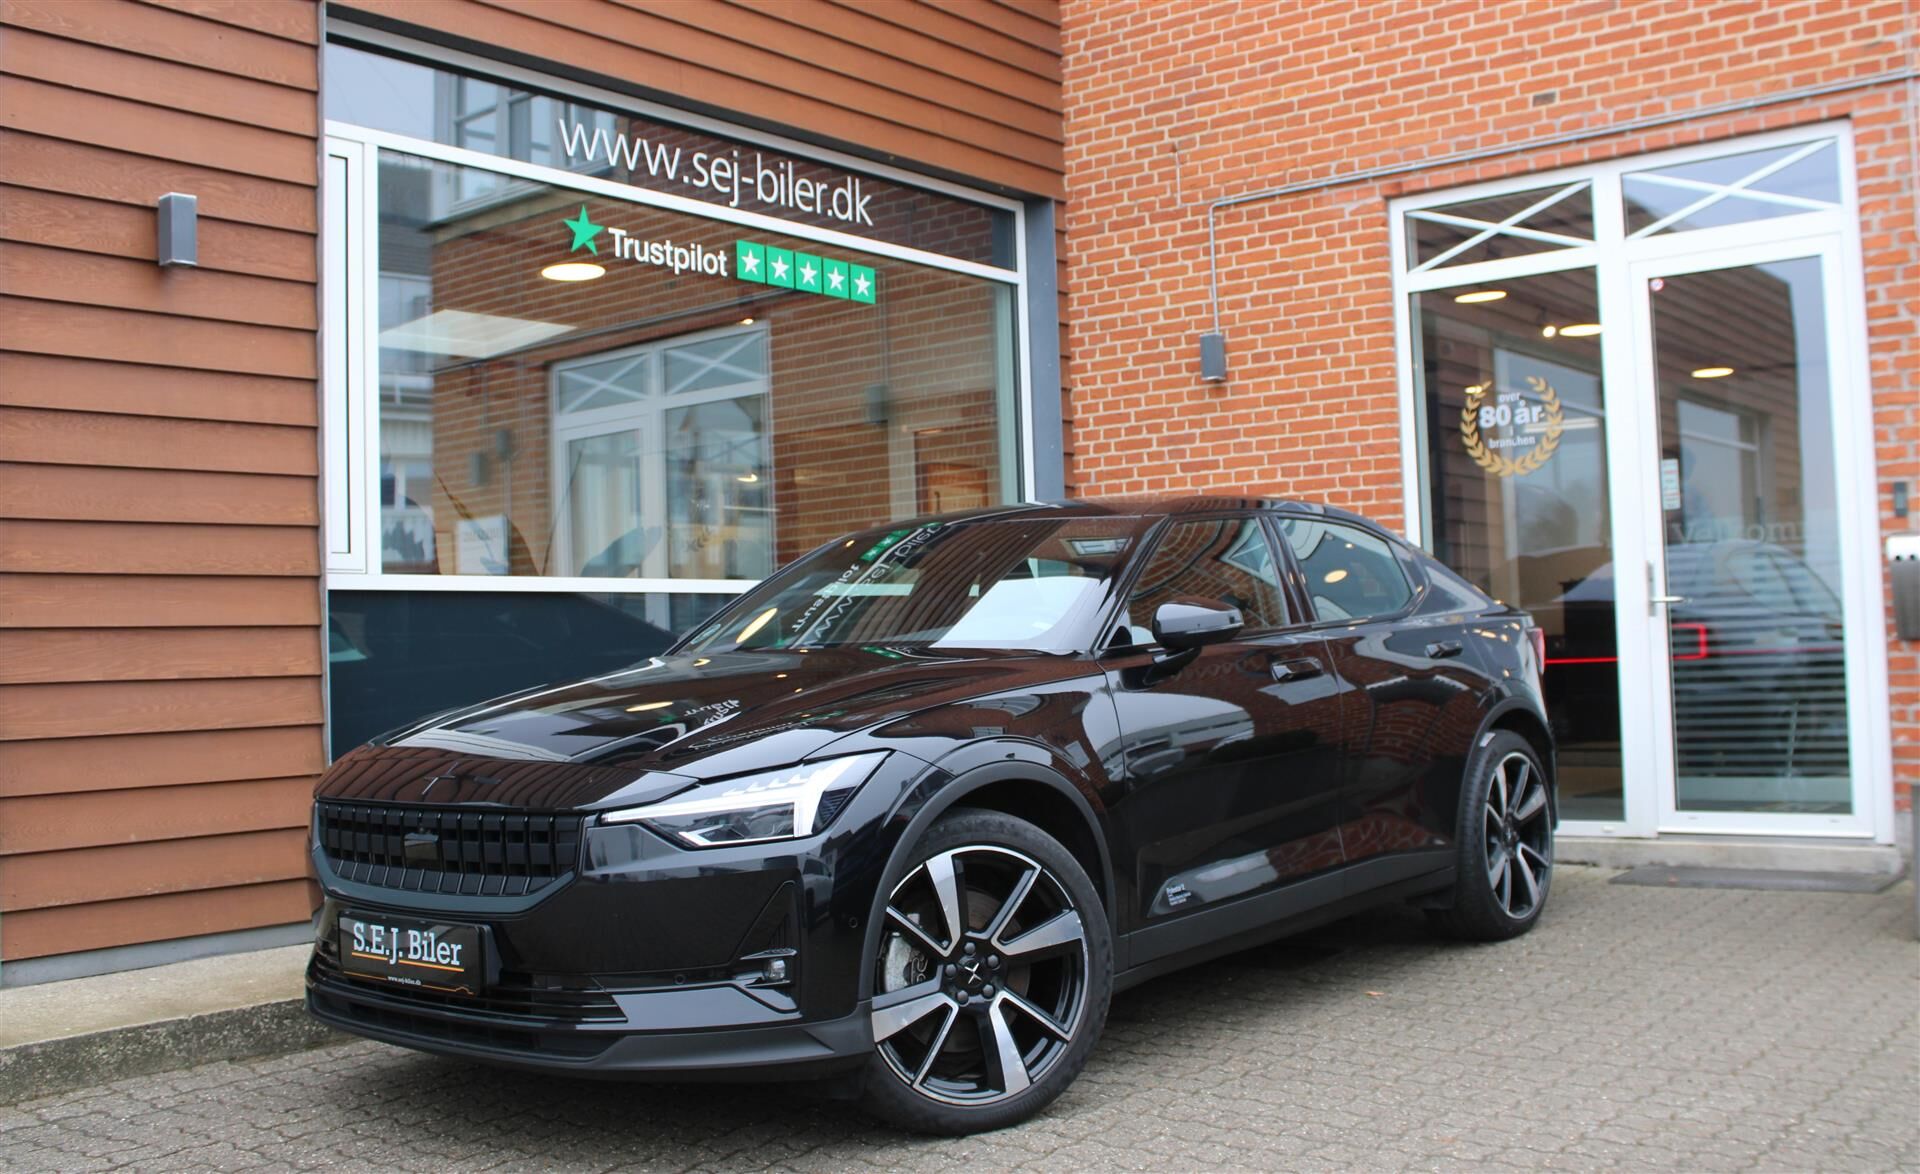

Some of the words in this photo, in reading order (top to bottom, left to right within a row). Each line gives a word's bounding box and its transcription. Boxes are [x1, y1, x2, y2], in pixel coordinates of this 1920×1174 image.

[559, 118, 873, 226] www.sej-biler.dk
[608, 227, 728, 277] Trustpilot
[1479, 403, 1512, 428] 80
[1498, 392, 1521, 402] over
[353, 922, 403, 965] S.E.J.
[408, 929, 462, 966] Biler
